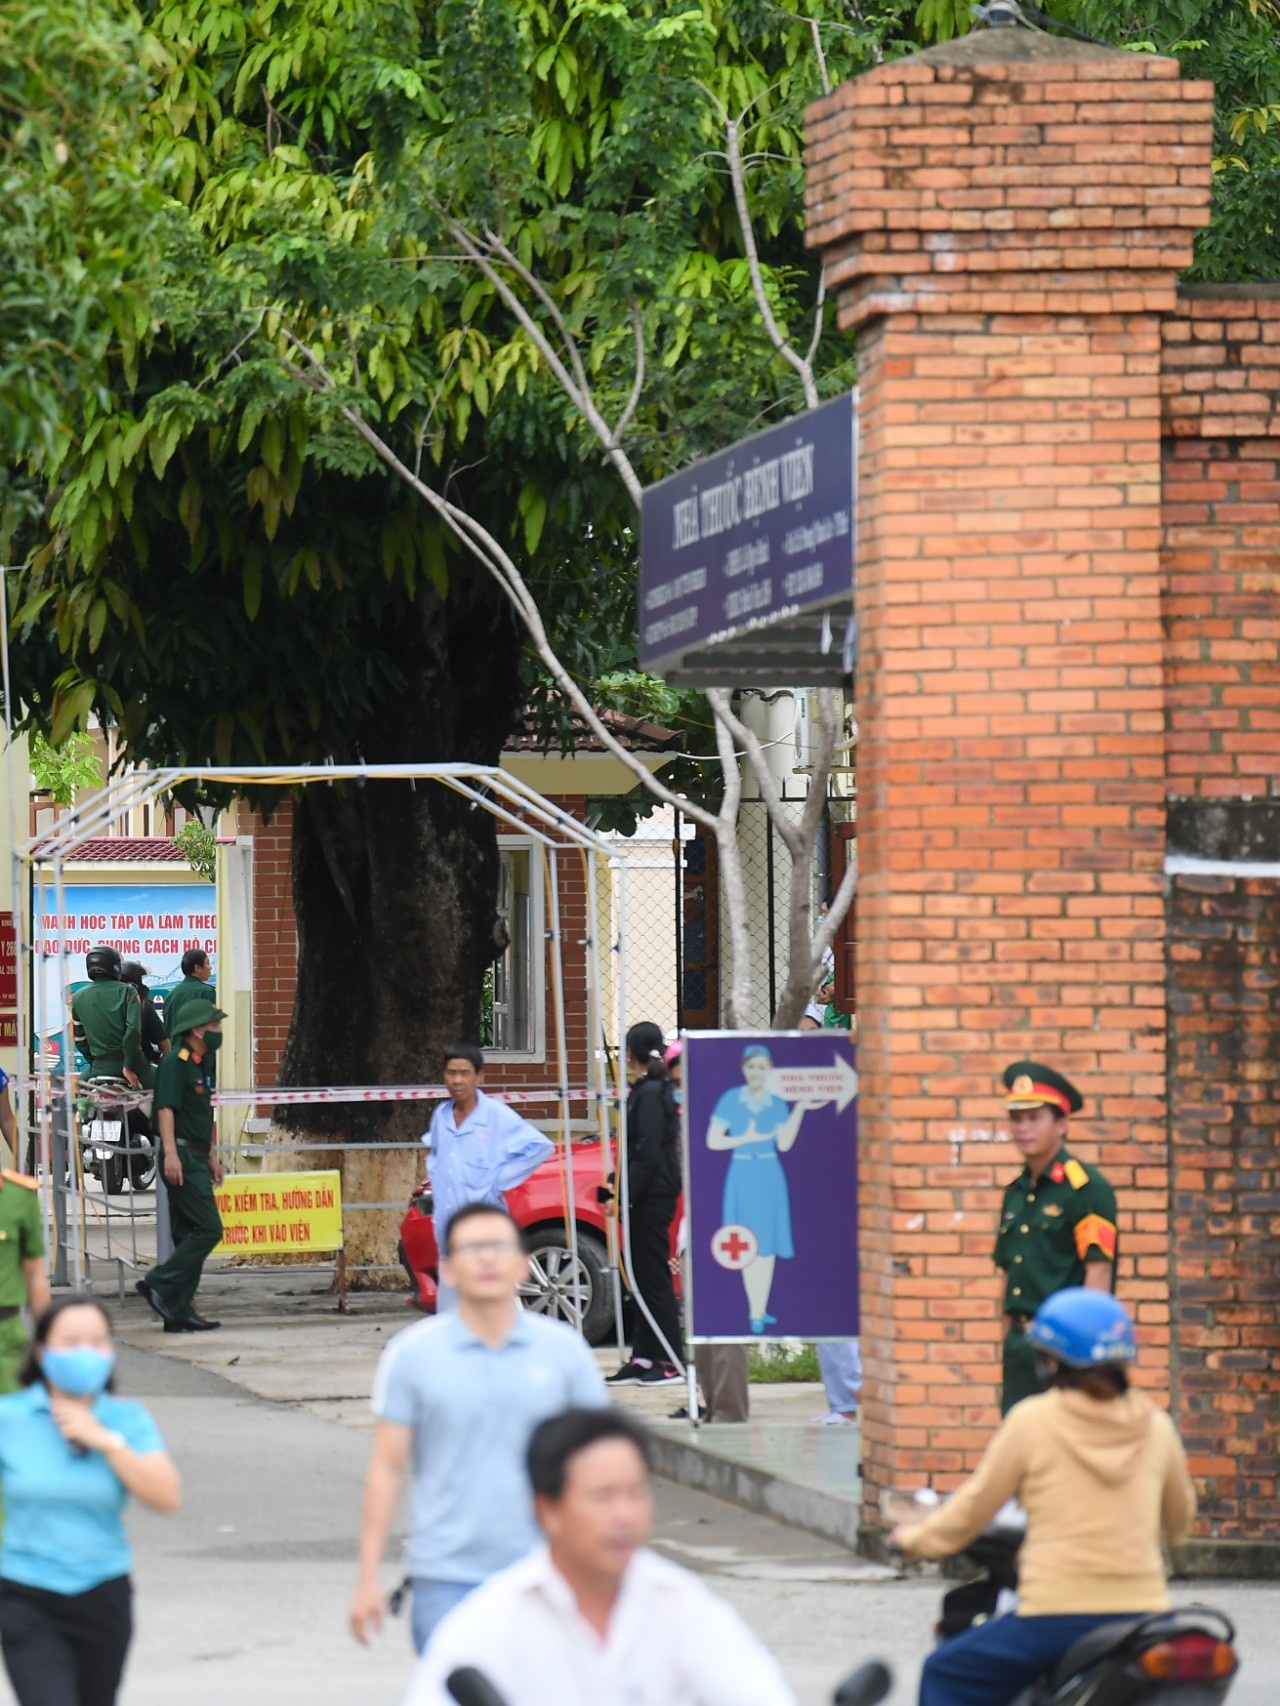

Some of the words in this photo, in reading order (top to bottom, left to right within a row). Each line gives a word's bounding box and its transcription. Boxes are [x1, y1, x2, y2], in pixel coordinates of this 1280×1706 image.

[80, 914, 107, 932] HỌC
[110, 912, 134, 932] TẬP
[137, 912, 155, 930] VÀ
[158, 912, 184, 929] LÀM
[0, 940, 6, 957] Y
[145, 937, 179, 954] CÁCH
[183, 934, 201, 954] HỒ
[3, 1020, 17, 1037] MÁ
[252, 1224, 267, 1244] KHI
[269, 1220, 287, 1243] VÀO
[290, 1219, 311, 1245] VIỆN
